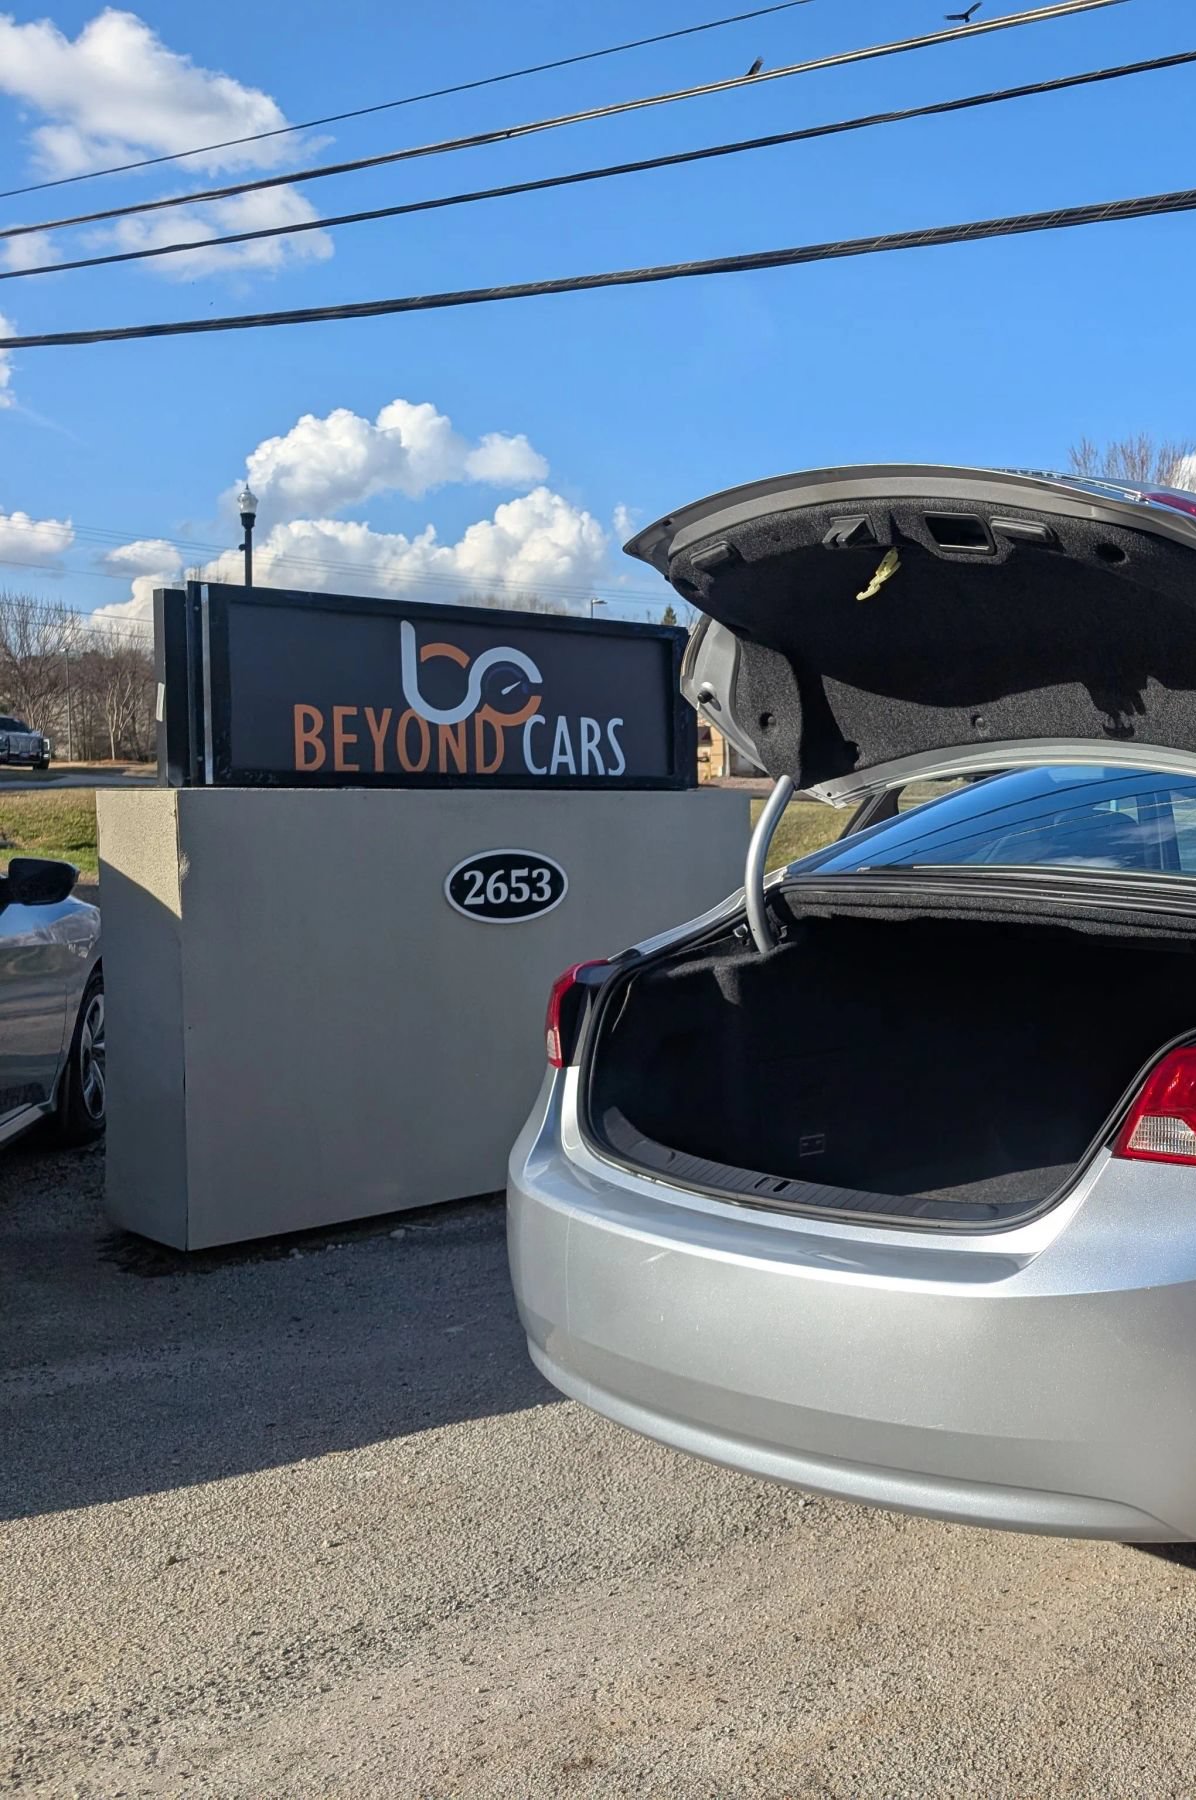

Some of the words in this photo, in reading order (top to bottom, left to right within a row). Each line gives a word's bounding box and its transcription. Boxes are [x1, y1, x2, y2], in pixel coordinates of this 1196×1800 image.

[294, 703, 505, 774] BEYOND
[523, 715, 627, 776] CARS
[463, 867, 552, 905] 2653
